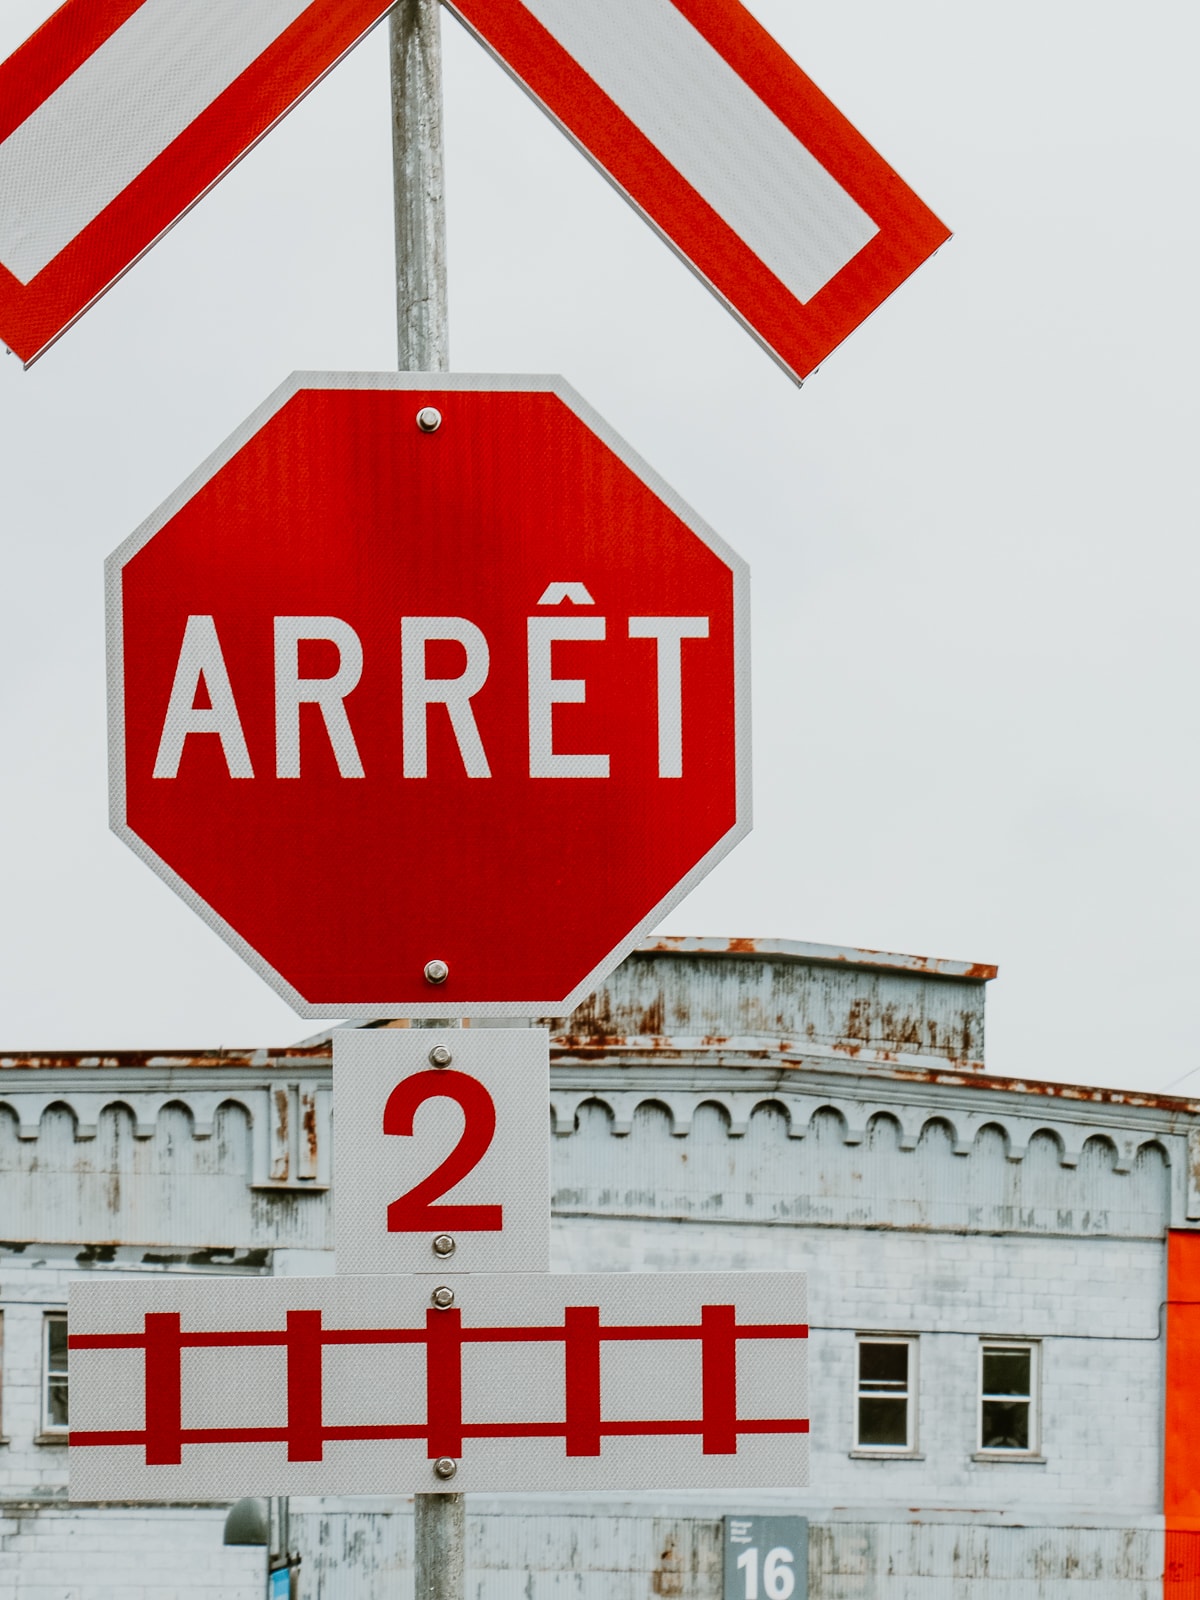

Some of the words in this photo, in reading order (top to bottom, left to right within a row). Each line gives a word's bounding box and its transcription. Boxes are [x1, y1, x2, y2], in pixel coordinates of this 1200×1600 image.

[152, 582, 709, 779] ARRÊT
[382, 1069, 503, 1232] 2
[736, 1546, 796, 1600] 16
